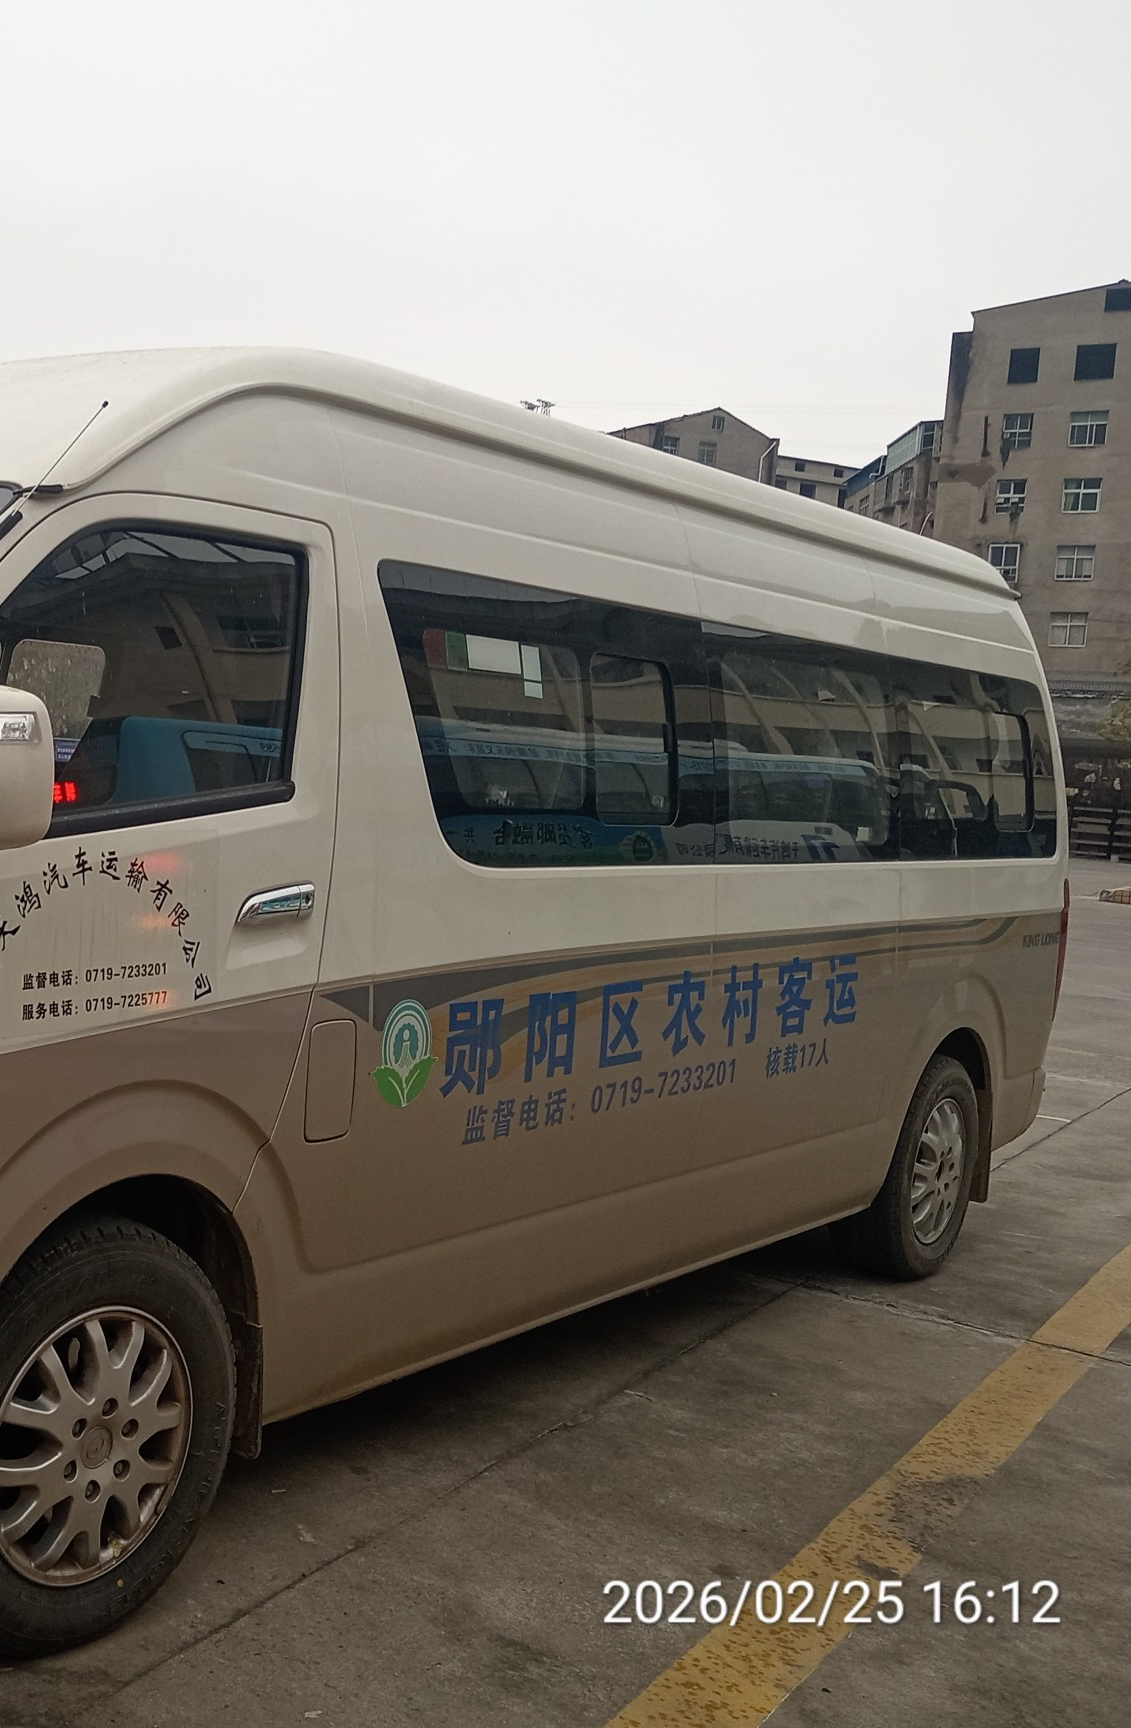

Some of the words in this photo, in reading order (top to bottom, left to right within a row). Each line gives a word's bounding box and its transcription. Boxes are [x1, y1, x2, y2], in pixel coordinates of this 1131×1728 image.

[439, 954, 858, 1098] 郧阳区农村客运
[764, 1037, 830, 1080] 核载17人
